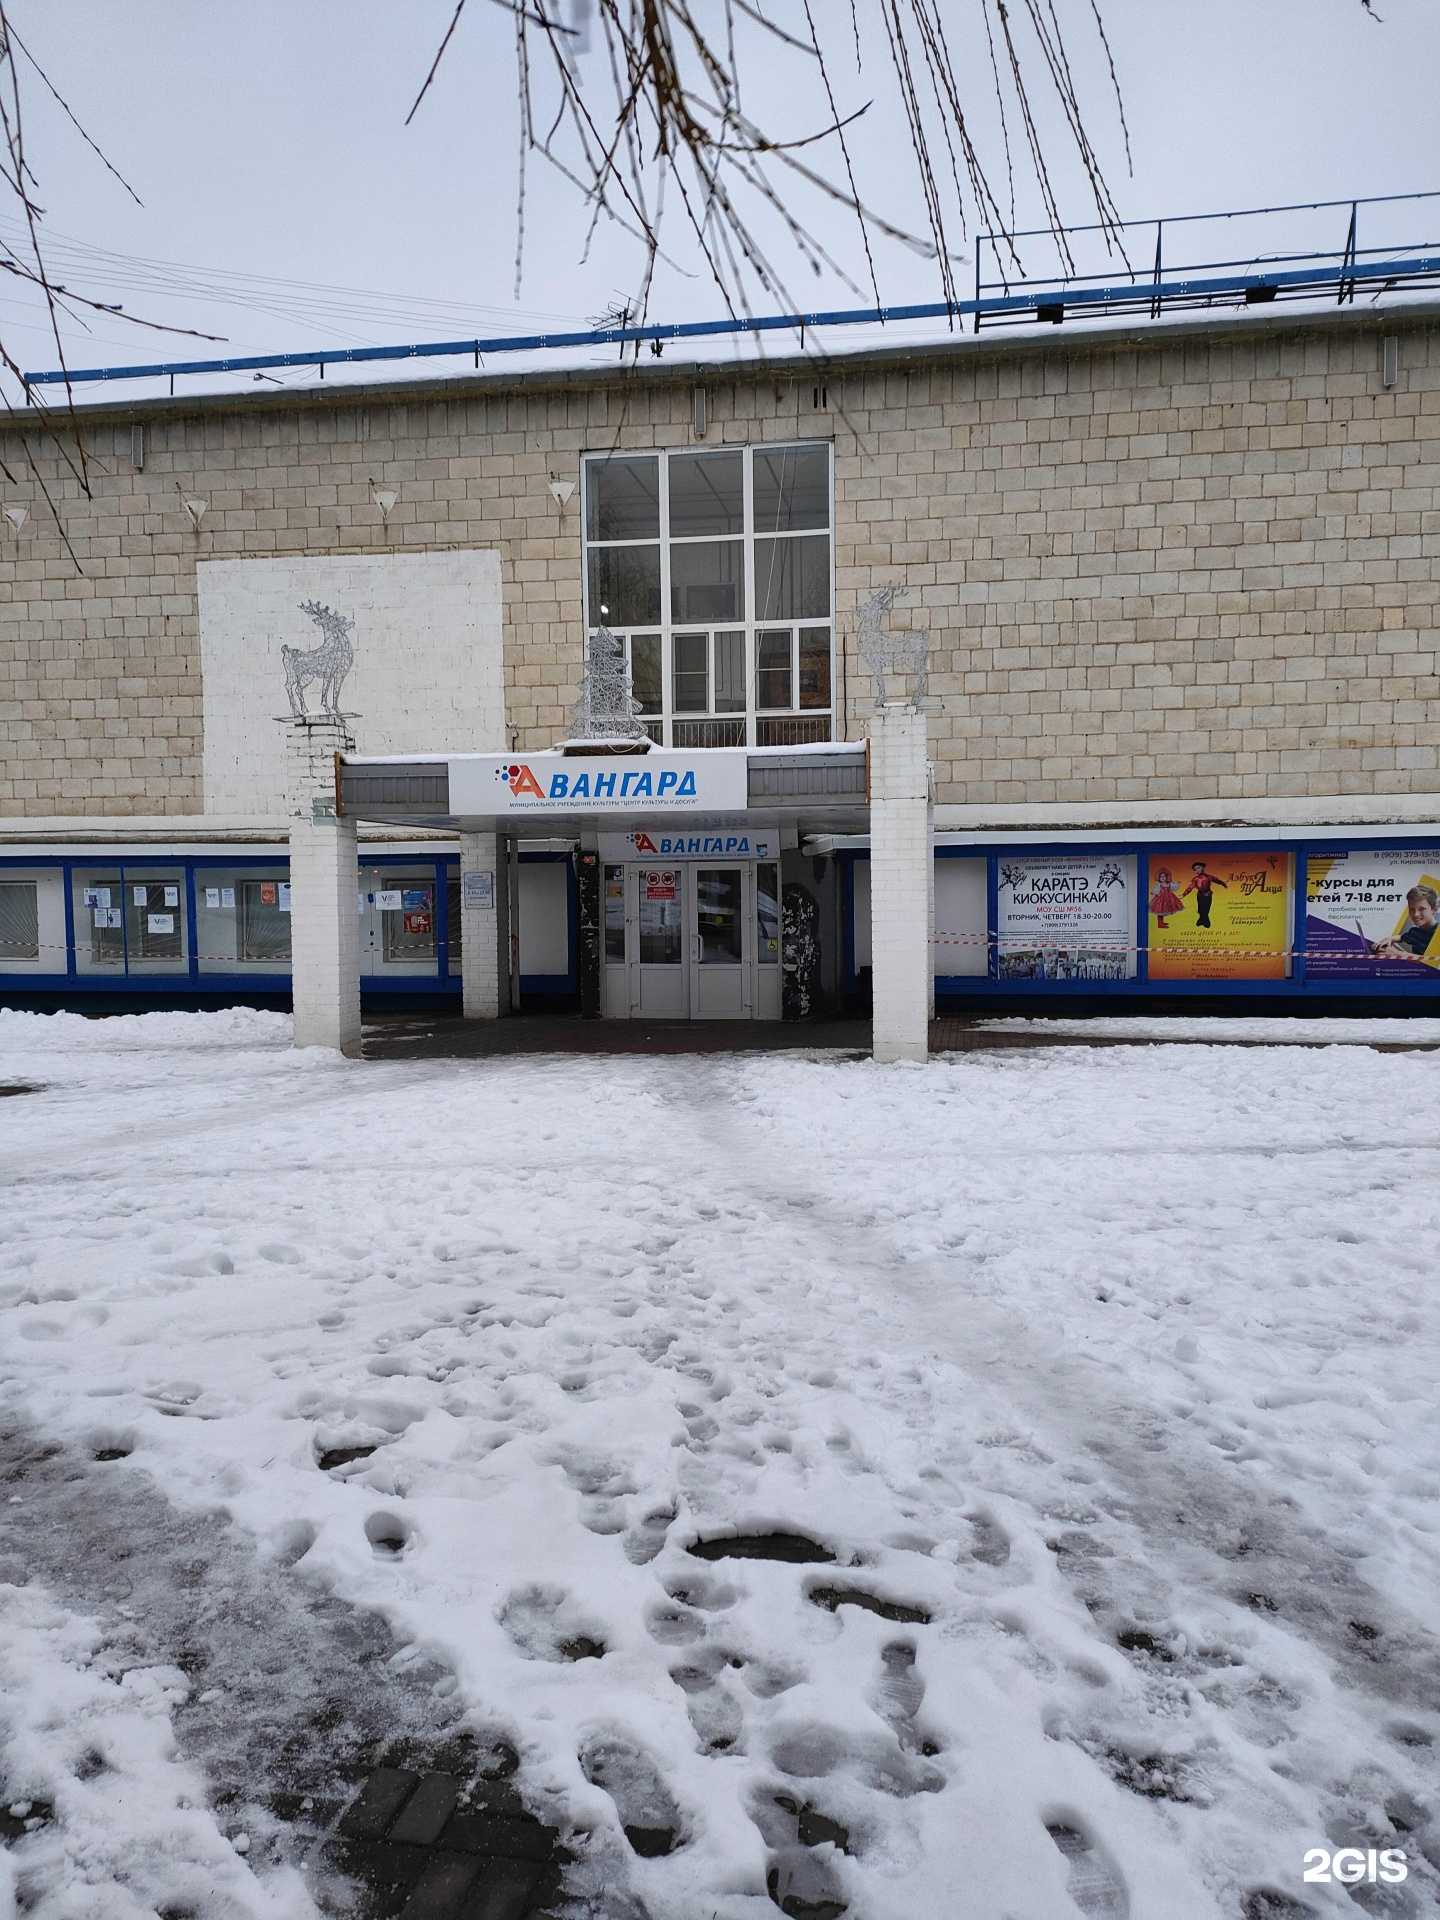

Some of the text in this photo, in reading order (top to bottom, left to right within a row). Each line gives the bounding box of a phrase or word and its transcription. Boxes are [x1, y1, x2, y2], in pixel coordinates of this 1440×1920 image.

[509, 765, 697, 798] АВАНГАРД
[636, 833, 750, 853] АВАНГАРД
[1031, 877, 1089, 891] КАРАТЭ
[1366, 878, 1395, 888] для
[1013, 889, 1108, 904] КИОКУСИНКАЙ
[1345, 892, 1373, 903] 7-18
[1376, 893, 1403, 902] лет
